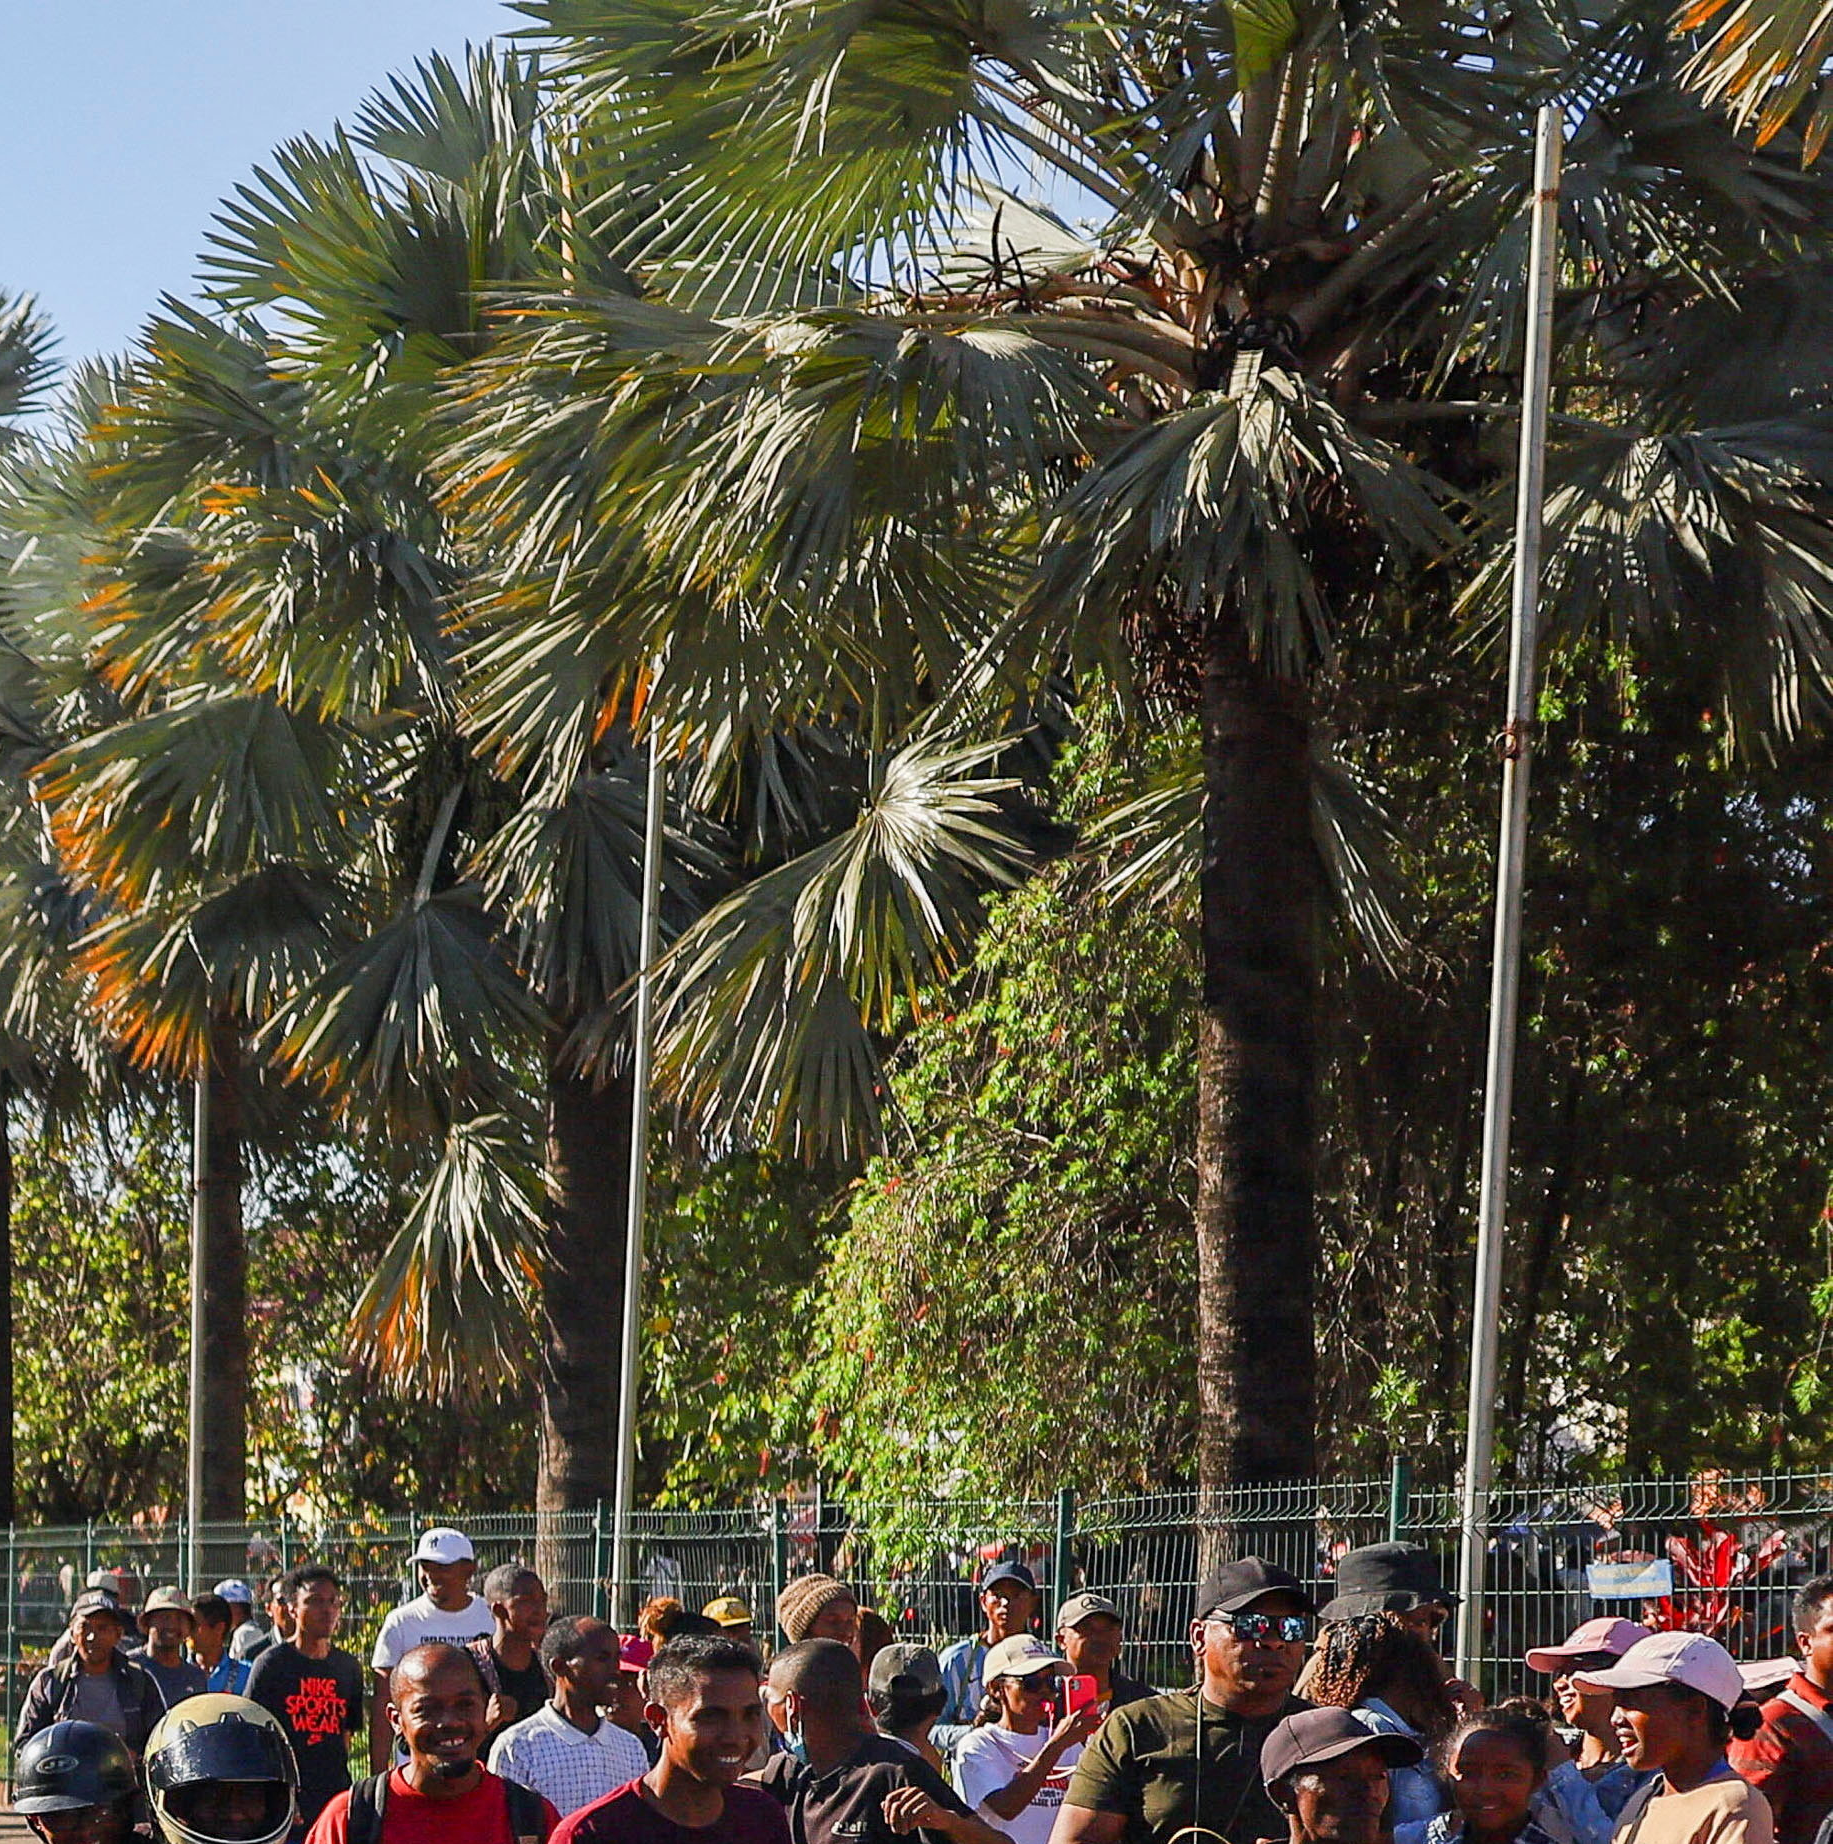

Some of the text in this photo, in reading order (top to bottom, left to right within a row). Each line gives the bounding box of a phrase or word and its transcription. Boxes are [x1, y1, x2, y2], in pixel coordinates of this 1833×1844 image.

[300, 1677, 337, 1698] NIKE
[285, 1695, 347, 1718] SPORTS
[292, 1713, 341, 1734] WEAR
